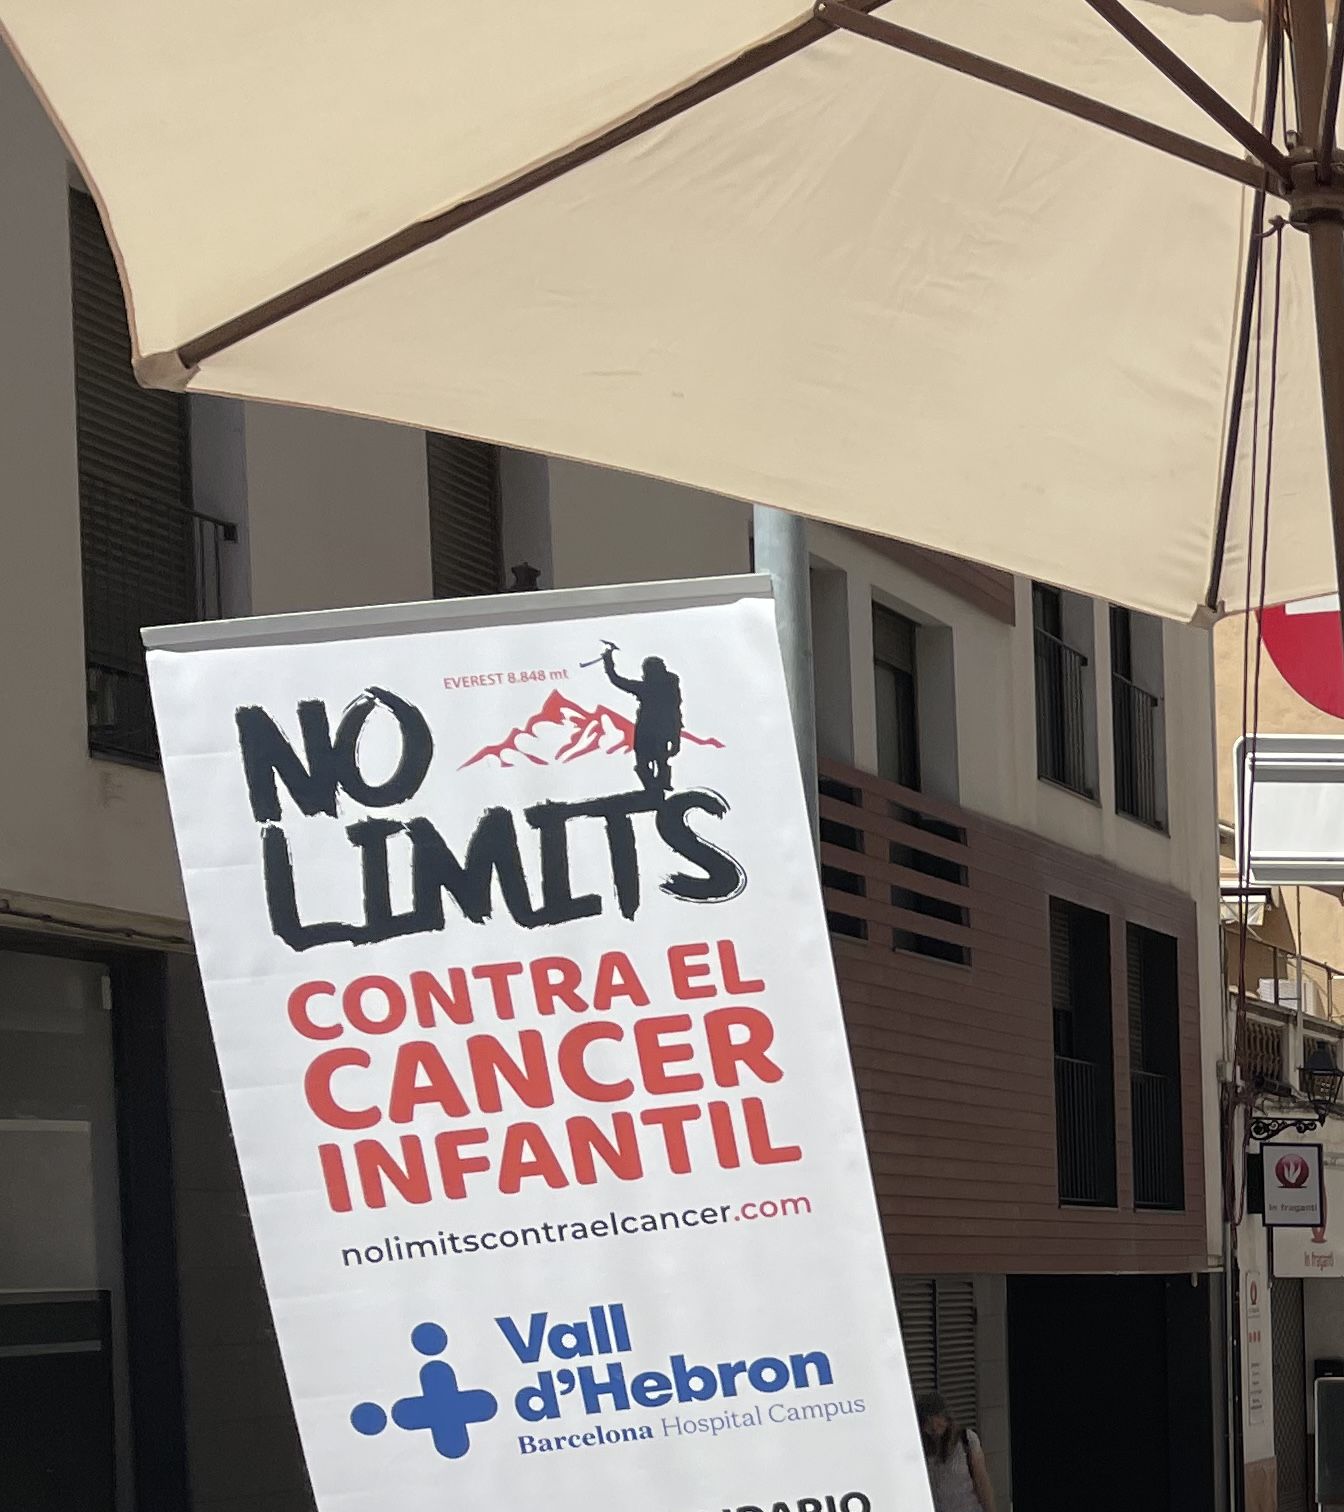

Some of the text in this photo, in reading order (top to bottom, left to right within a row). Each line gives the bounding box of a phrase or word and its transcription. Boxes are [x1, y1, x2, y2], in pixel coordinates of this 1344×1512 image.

[443, 666, 569, 691] EVEREST 8.848 mt
[235, 685, 435, 823] NO
[261, 785, 749, 953] LIMITS
[286, 939, 766, 1041] CONTRA EL
[303, 1005, 784, 1130] CANCER
[318, 1097, 802, 1214] INFANTIL
[341, 1193, 813, 1267] nolimitscontraelcancer.com
[495, 1303, 632, 1364] Vall
[514, 1347, 834, 1423] d’Hebron
[517, 1394, 866, 1456] Barcelona Hospital Campus
